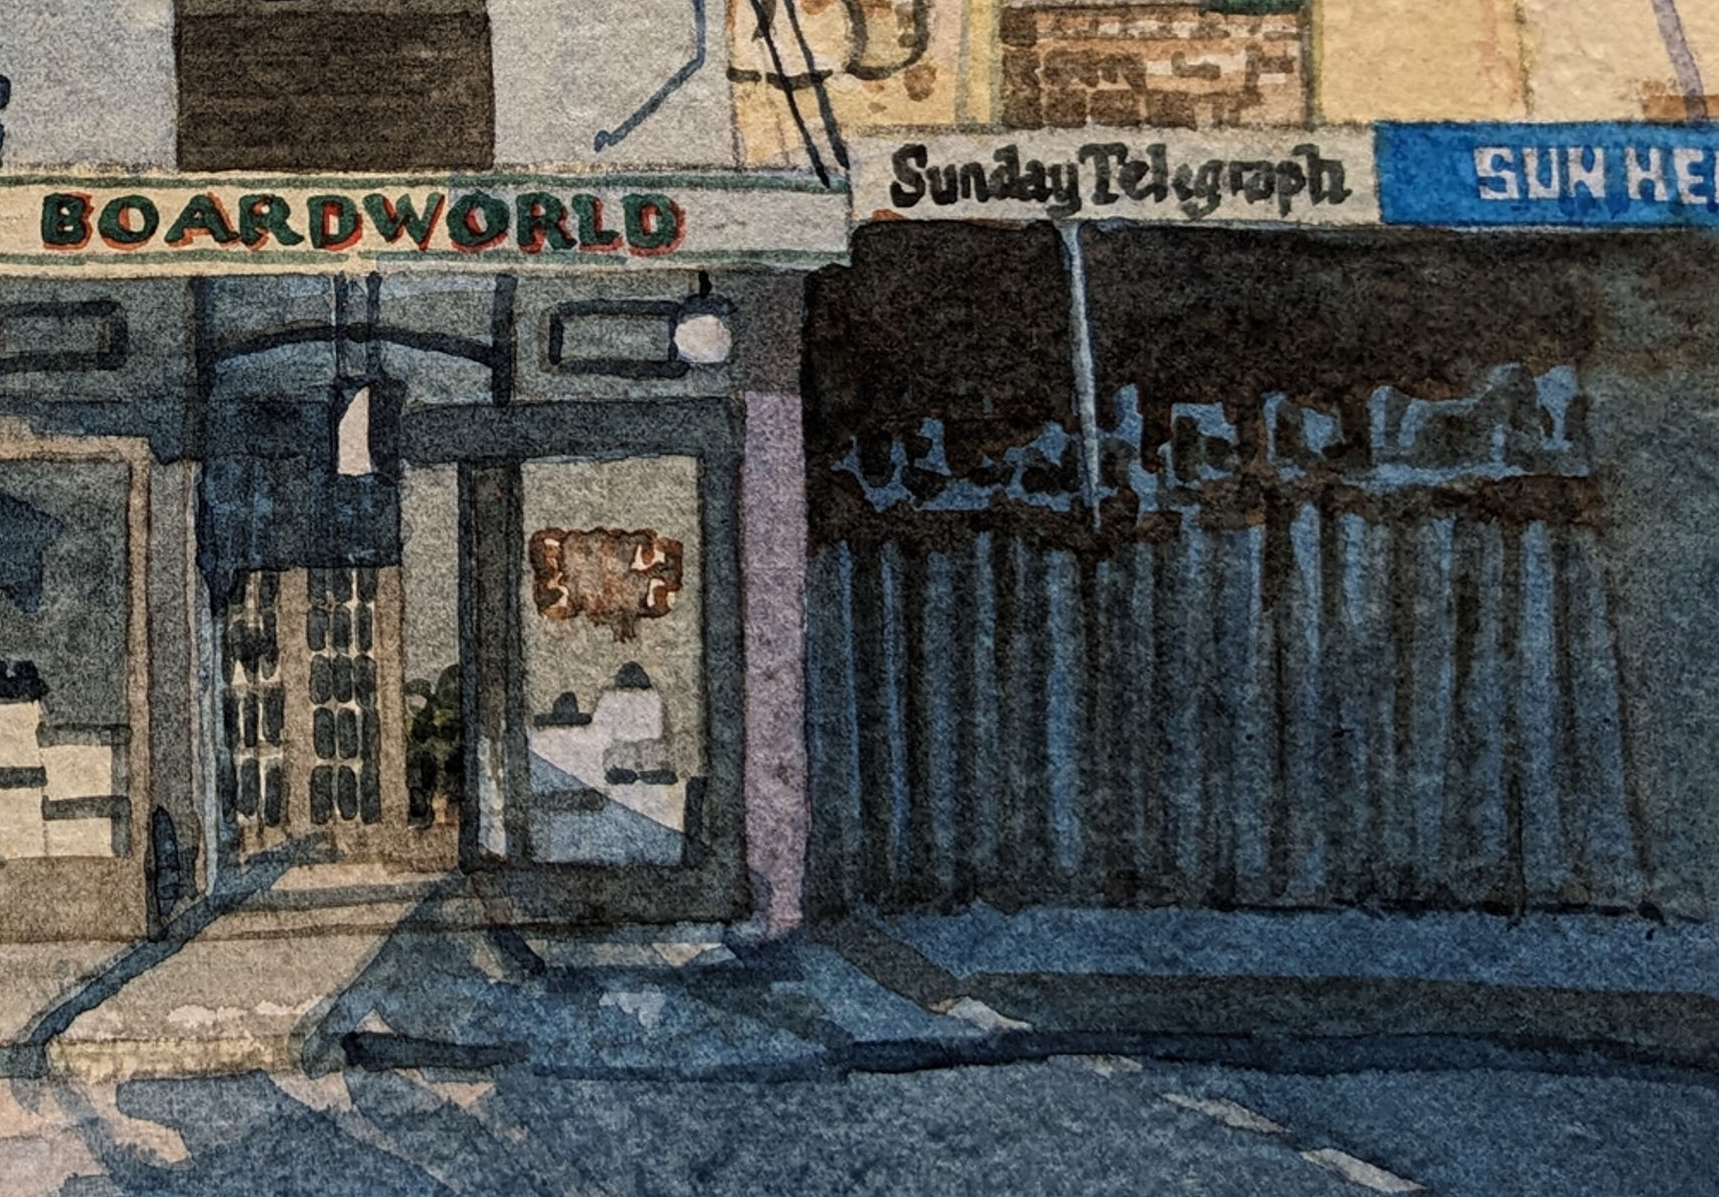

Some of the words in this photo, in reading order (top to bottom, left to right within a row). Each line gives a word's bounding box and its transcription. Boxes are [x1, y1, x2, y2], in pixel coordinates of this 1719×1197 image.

[890, 144, 1081, 218] Sunday
[1473, 146, 1606, 201] SUN
[1624, 146, 1719, 204] HE
[39, 191, 687, 258] BOARDWORLD
